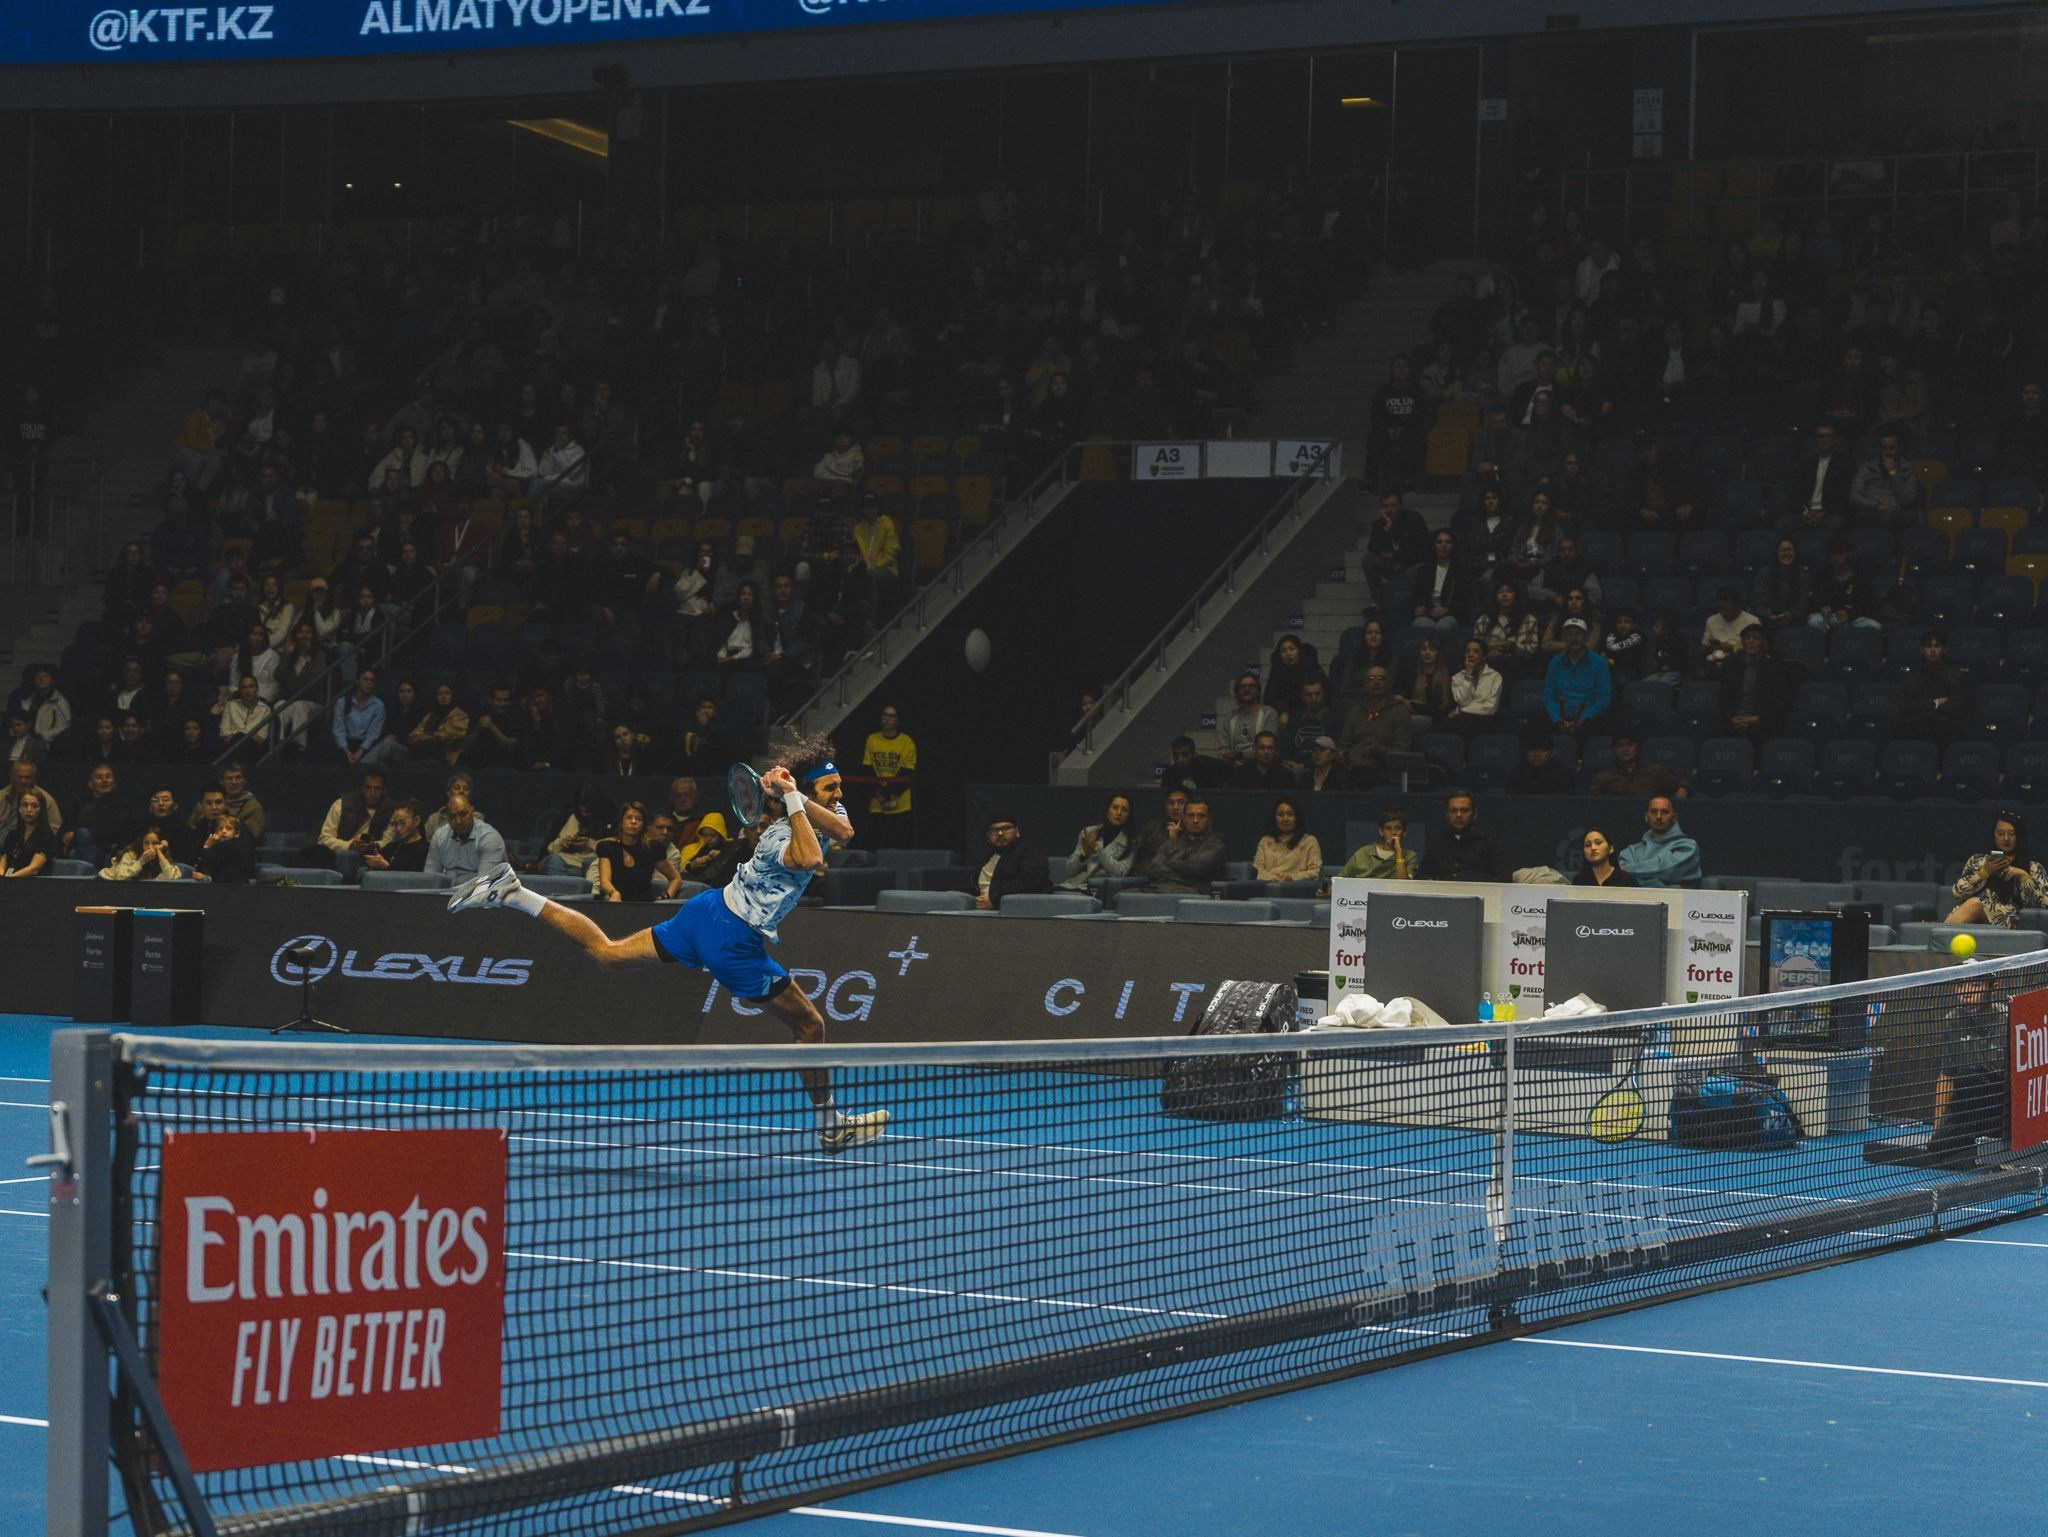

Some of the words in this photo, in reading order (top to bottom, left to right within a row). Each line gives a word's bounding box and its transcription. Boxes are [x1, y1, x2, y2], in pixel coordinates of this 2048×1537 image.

[89, 5, 275, 51] @KTF.KZ
[1155, 448, 1181, 463] A3
[1407, 920, 1448, 928] LEXUS
[1591, 928, 1635, 936] LEXUS
[341, 950, 534, 986] LEXUS
[1686, 963, 1734, 983] forte
[1779, 973, 1820, 983] PEPSI
[2027, 1075, 2043, 1119] FLY
[184, 1186, 489, 1304] Emirates
[230, 1318, 302, 1408] FLY
[309, 1308, 447, 1401] BETTER
